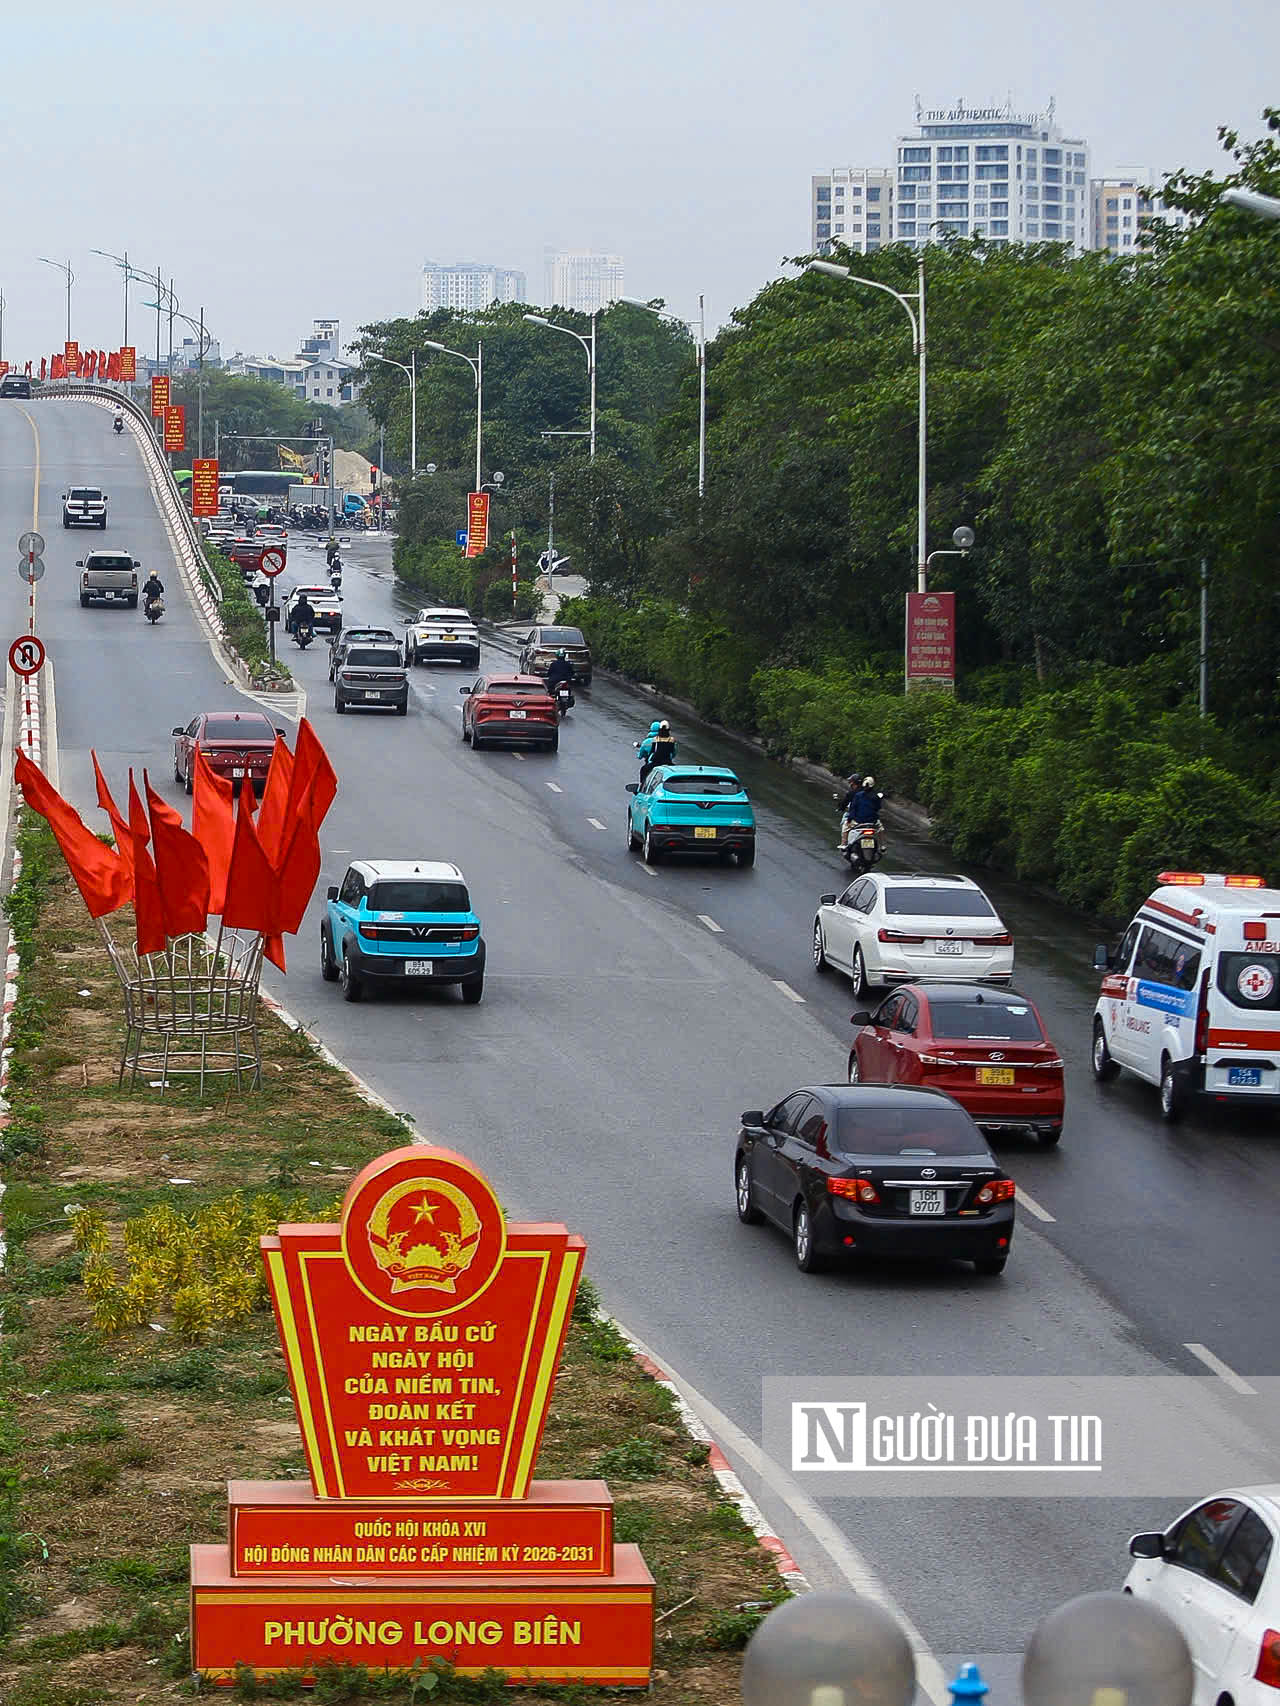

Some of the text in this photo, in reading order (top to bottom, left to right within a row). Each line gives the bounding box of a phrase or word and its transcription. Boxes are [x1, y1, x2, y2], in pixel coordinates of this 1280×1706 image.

[920, 1190, 938, 1200] 16M
[914, 1201, 941, 1212] 9707
[349, 1320, 497, 1342] NGÀY BẦU CỬ
[372, 1348, 474, 1371] NGÀY HỘI
[344, 1373, 501, 1396] CỦA NIỀM TIN,
[368, 1399, 476, 1420] ĐOÀN KẾT
[344, 1426, 501, 1448] VÀ KHÁT VỌNG
[367, 1453, 478, 1475] VIỆT NAM!
[354, 1518, 487, 1540] QUỐC HỘI KHÓA XVI
[244, 1542, 594, 1566] HỘI ĐỒNG NHÂN DÂN CÁC CẤP NHIỆM KỲ 2026-2031
[264, 1614, 582, 1646] PHƯỜNG LONG BIÊN
